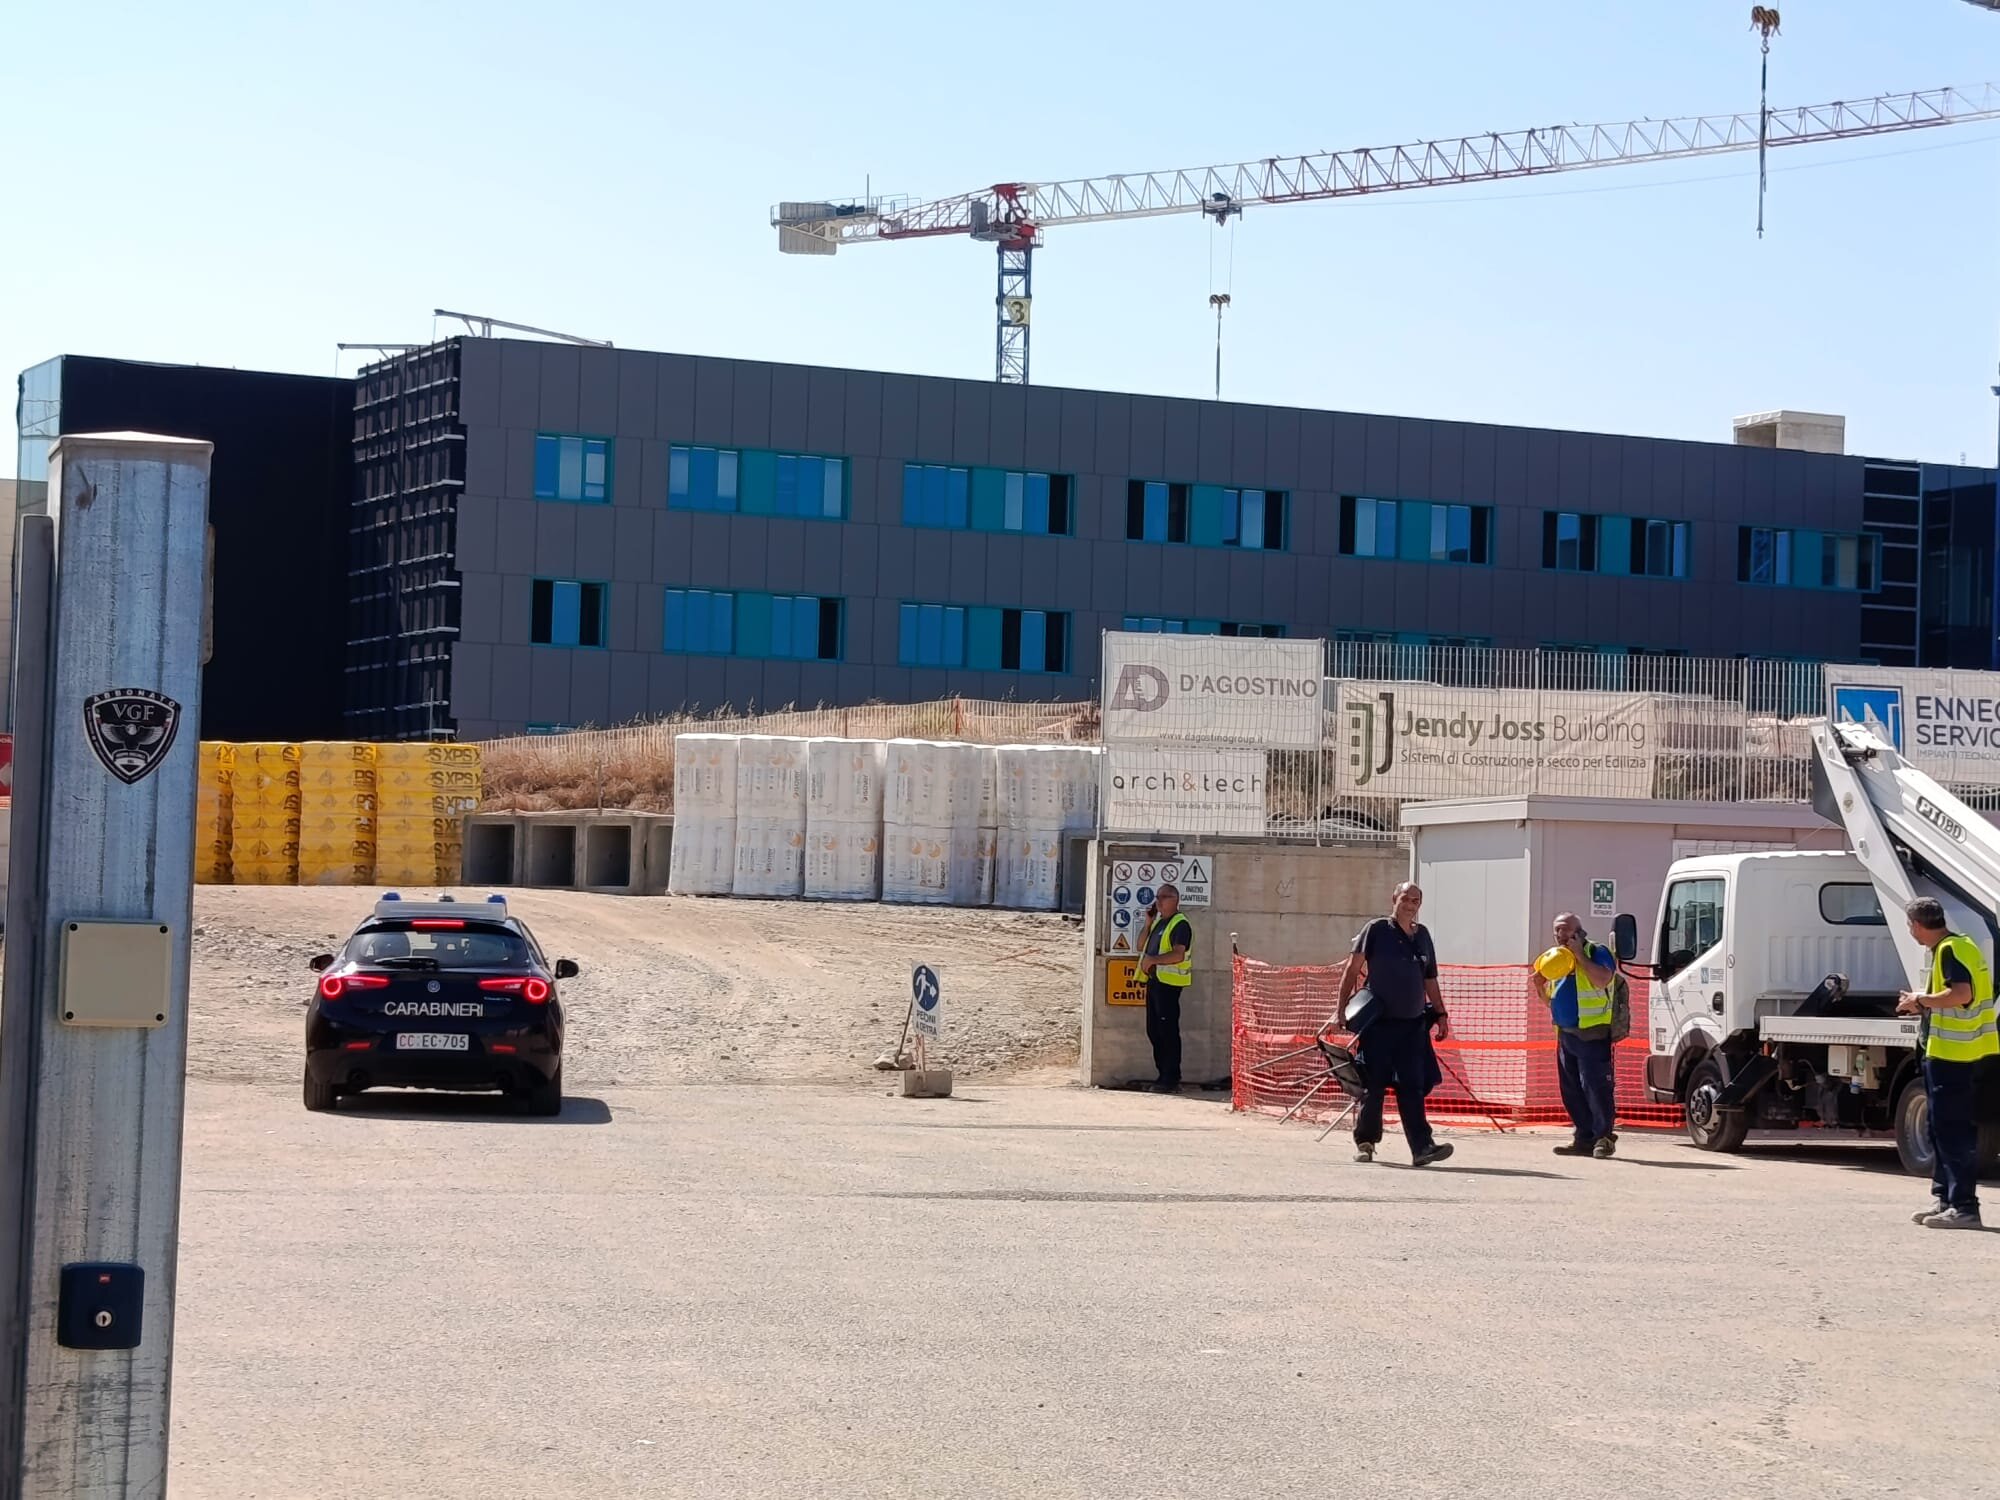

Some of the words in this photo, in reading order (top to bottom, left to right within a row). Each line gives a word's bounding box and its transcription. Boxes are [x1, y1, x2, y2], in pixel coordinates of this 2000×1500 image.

[1011, 301, 1025, 323] 3
[1180, 674, 1317, 698] D'AGOSTINO
[94, 689, 176, 708] ABBONATO
[112, 703, 155, 720] VGF
[1401, 711, 1483, 746] Jendy
[1489, 714, 1545, 741] Joss
[1553, 714, 1646, 749] Building
[1401, 751, 1444, 764] Sistemi
[1447, 753, 1458, 765] di
[1462, 753, 1534, 768] Costruzione
[1547, 758, 1580, 768] secco
[1583, 759, 1602, 771] per
[1606, 755, 1646, 769] Edilizia
[384, 1001, 483, 1017] CARABINIERI
